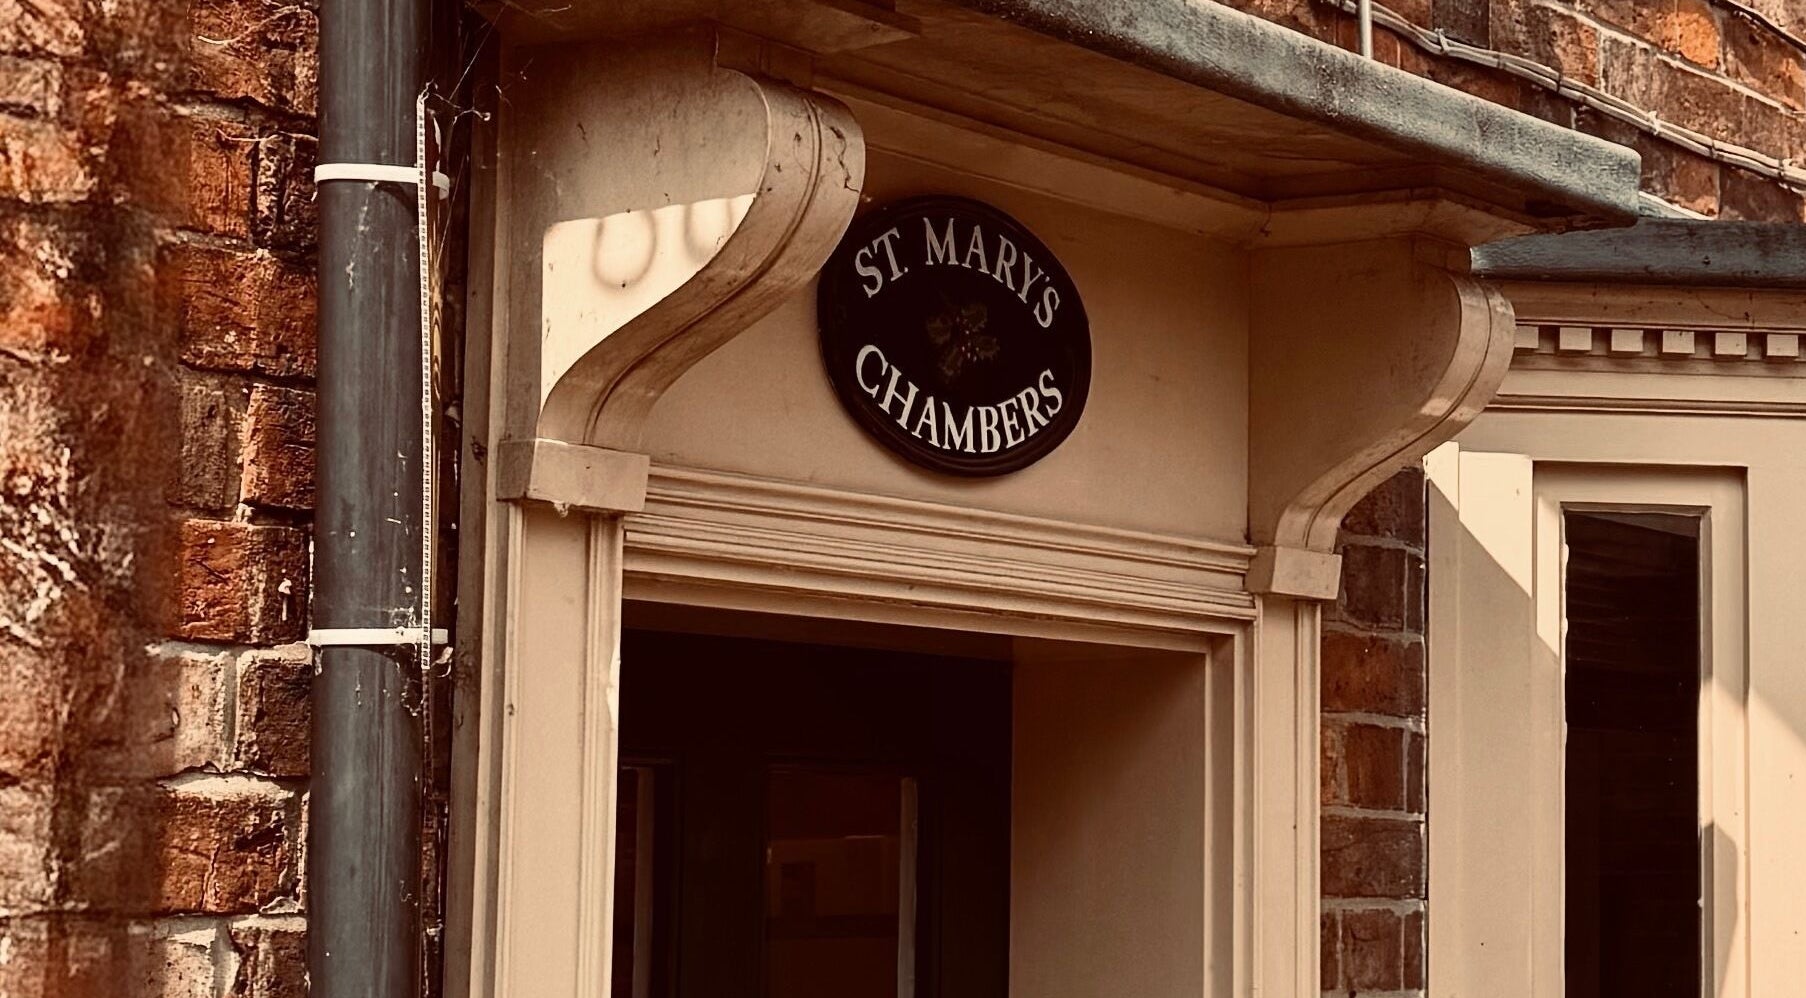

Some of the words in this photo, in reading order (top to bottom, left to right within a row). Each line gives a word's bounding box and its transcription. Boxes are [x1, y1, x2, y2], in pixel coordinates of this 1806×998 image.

[855, 227, 908, 298] ST.
[923, 217, 1060, 328] MARY'S
[856, 344, 1063, 454] CHAMBERS
